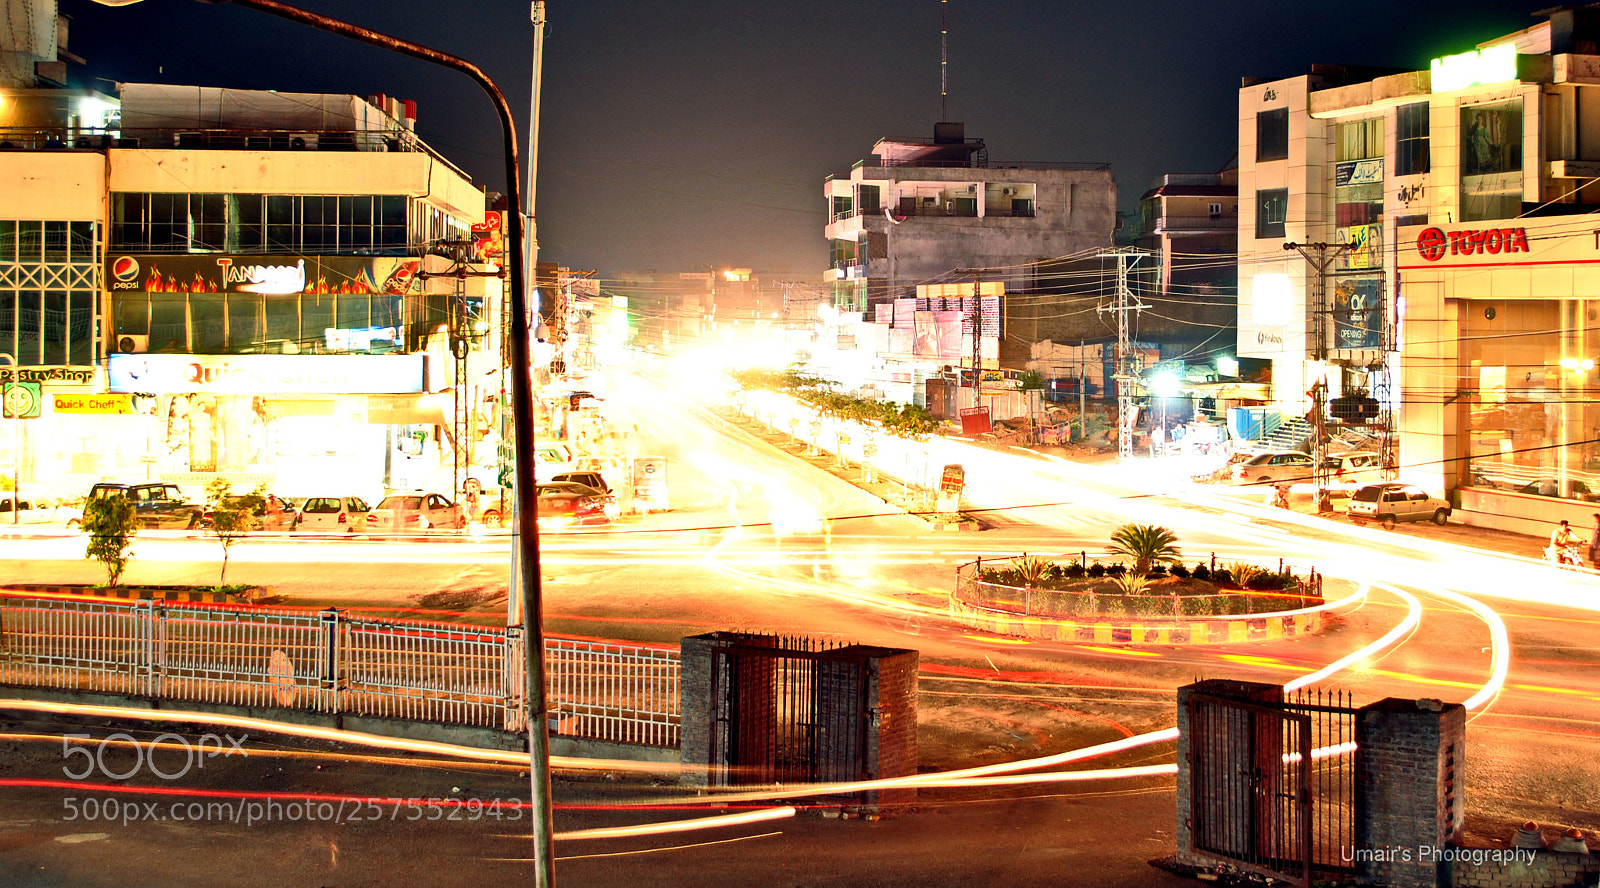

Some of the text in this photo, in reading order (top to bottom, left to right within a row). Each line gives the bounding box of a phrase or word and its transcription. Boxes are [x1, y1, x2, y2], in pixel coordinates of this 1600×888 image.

[1446, 227, 1530, 256] TOYOTA
[113, 281, 139, 290] pepsi
[55, 399, 115, 409] Quick Cheff
